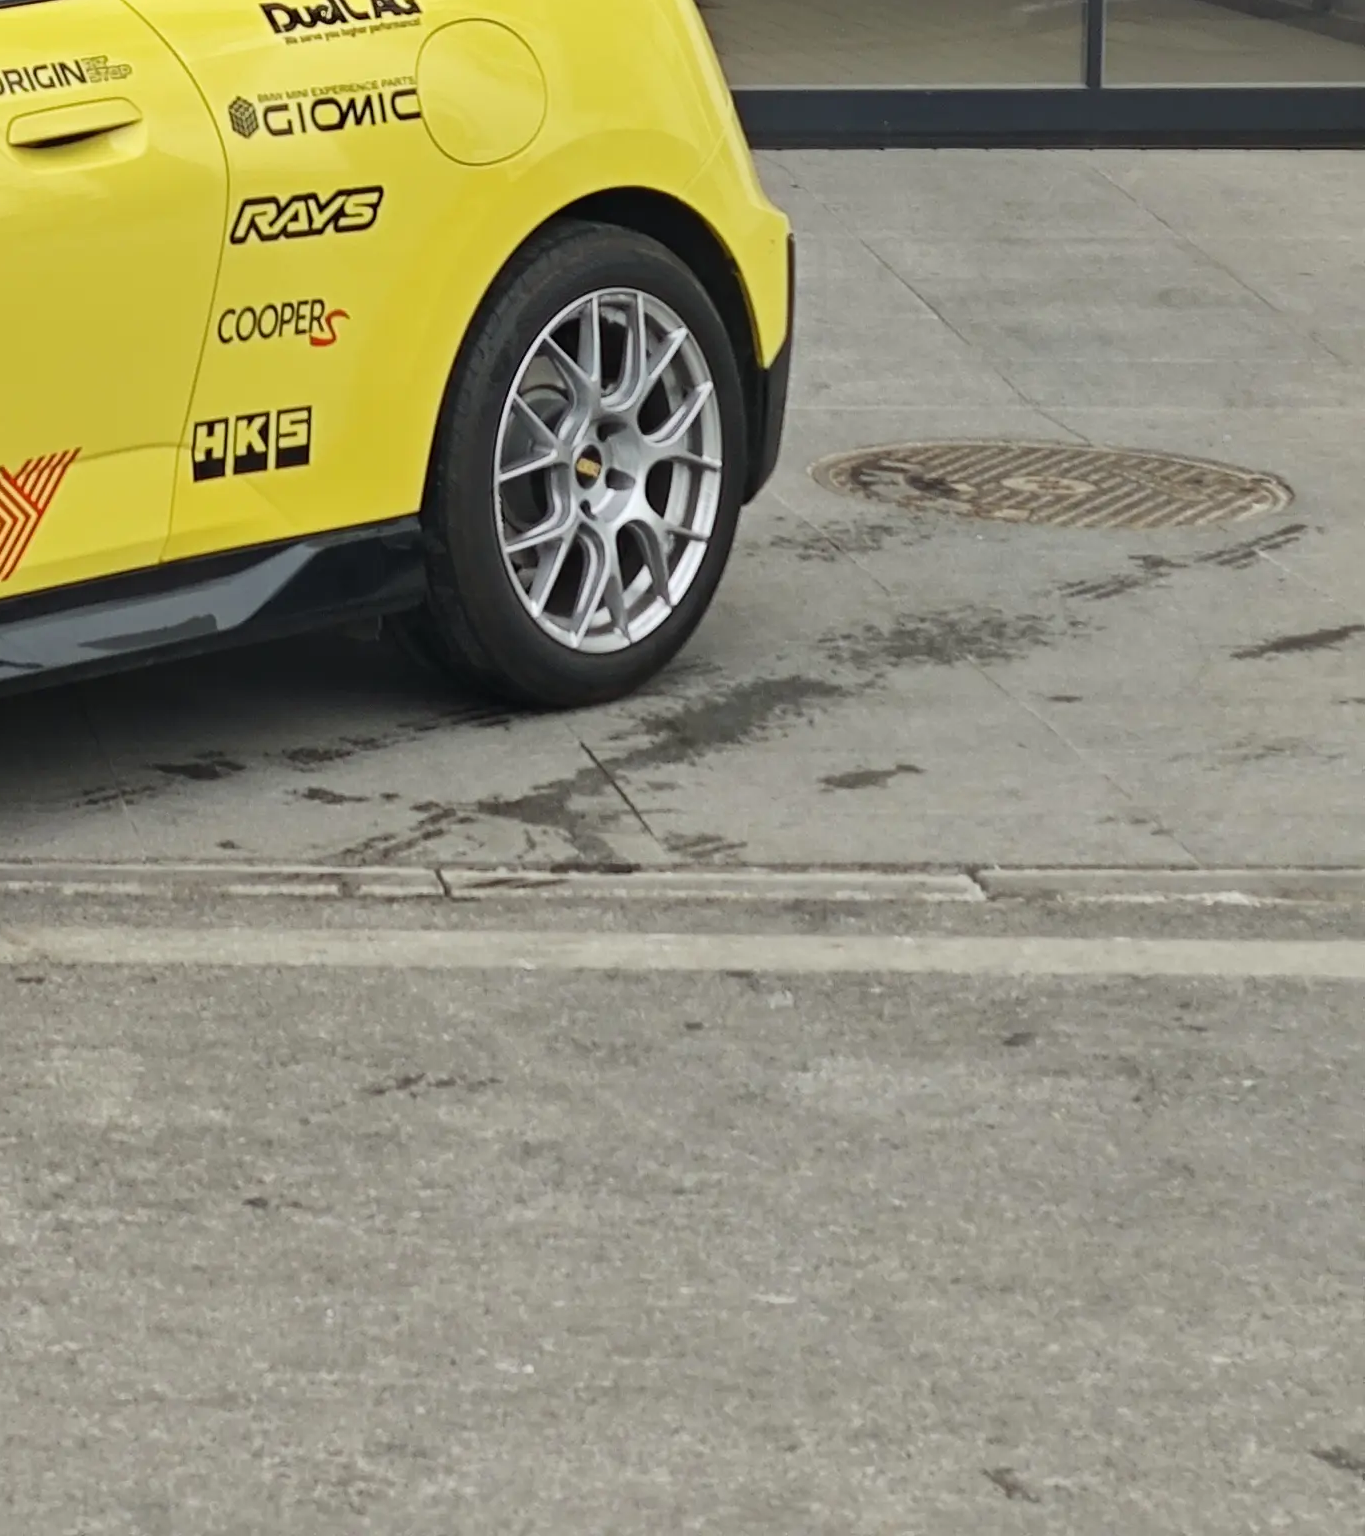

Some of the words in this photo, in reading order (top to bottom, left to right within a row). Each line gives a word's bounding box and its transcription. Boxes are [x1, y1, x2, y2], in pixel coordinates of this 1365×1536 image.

[325, 31, 340, 42] you
[263, 88, 423, 136] GIOMIC
[286, 88, 309, 100] MINI
[311, 80, 379, 98] EXPERIENCE
[230, 185, 384, 245] RAYS
[193, 408, 310, 467] HKS
